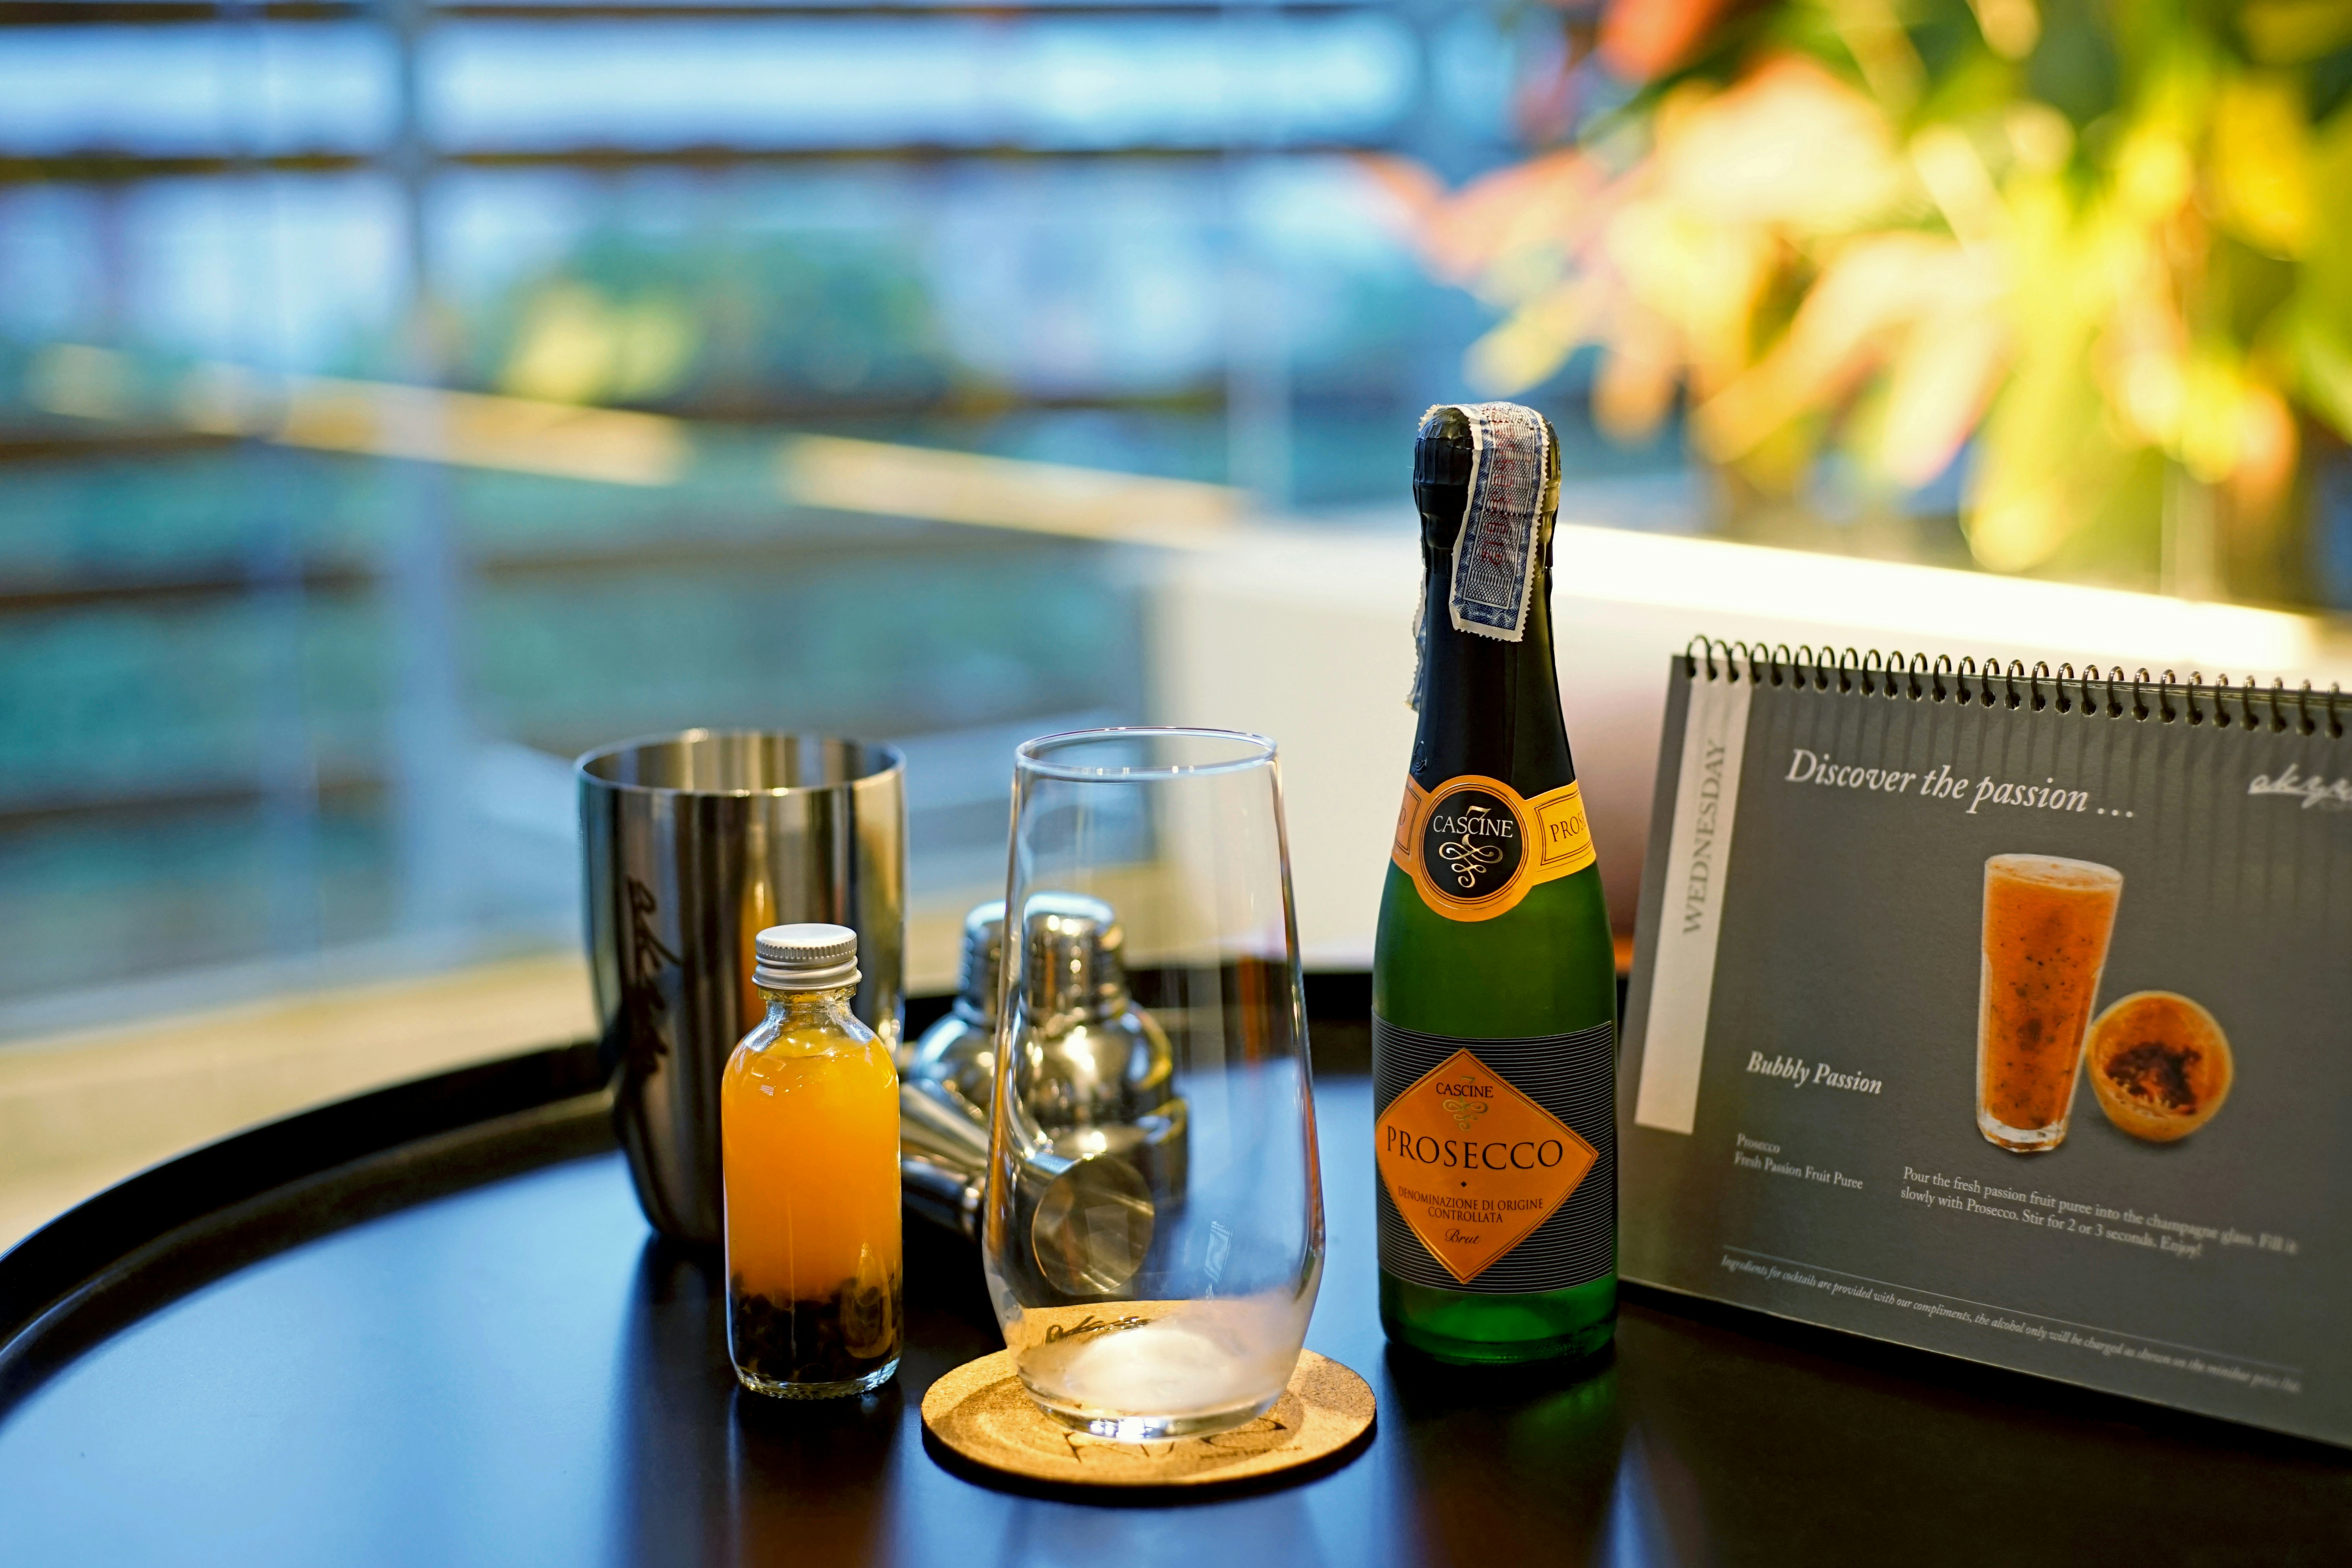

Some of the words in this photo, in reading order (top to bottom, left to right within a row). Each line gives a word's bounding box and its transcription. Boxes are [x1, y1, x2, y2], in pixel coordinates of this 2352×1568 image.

[1785, 748, 1916, 793] Discover
[1920, 764, 1969, 799] the
[1965, 776, 2088, 814] passion
[1433, 815, 1513, 837] CASCINE
[1683, 739, 1726, 935] WEDNESDAY
[1436, 1083, 1493, 1098] CASCINE
[1746, 1050, 1810, 1088] Bubbly
[1812, 1063, 1882, 1094] Passion
[1387, 1125, 1563, 1170] PROSECCO
[1737, 1132, 1780, 1153] Prosecco
[1734, 1151, 1762, 1169] Fresh
[1764, 1157, 1802, 1178] Passion
[1805, 1165, 1830, 1183] Fruit
[1833, 1171, 1863, 1190] Puree
[1399, 1186, 1478, 1210] DENOMINAZIONE
[1482, 1200, 1494, 1210] DI
[1497, 1198, 1544, 1210] ORIGINE
[1428, 1206, 1503, 1223] CONTROLLATA
[1900, 1186, 1935, 1207] slowly
[1938, 1195, 1963, 1209] with
[1966, 1198, 2019, 1220] Prosecco.
[2022, 1209, 2044, 1225] Stir
[2047, 1214, 2065, 1229] for
[2067, 1219, 2076, 1232] 2
[2078, 1223, 2093, 1234] or
[2095, 1223, 2103, 1237] 3
[2106, 1230, 2157, 1247] seconds.
[1903, 1166, 1930, 1183] Pour
[1933, 1173, 1951, 1187] the
[1953, 1176, 1980, 1193] fresh
[1983, 1187, 2027, 1203] passion
[2029, 1191, 2057, 1208] fruit
[2058, 1200, 2092, 1214] puree
[2095, 1203, 2120, 1220] into
[2123, 1209, 2144, 1225] the
[2145, 1214, 2219, 1240] champagne
[1445, 1228, 1481, 1244] Brut
[1766, 1266, 1782, 1280] for
[1782, 1271, 1816, 1287] cocktails
[1817, 1279, 1832, 1290] are
[1831, 1283, 1873, 1299] provided
[1873, 1292, 1895, 1305] with
[1896, 1298, 1912, 1308] our
[1913, 1302, 1972, 1323] compliments,
[1974, 1313, 1989, 1325] the
[1991, 1317, 2026, 1333] alcohol
[2025, 1326, 2046, 1341] only
